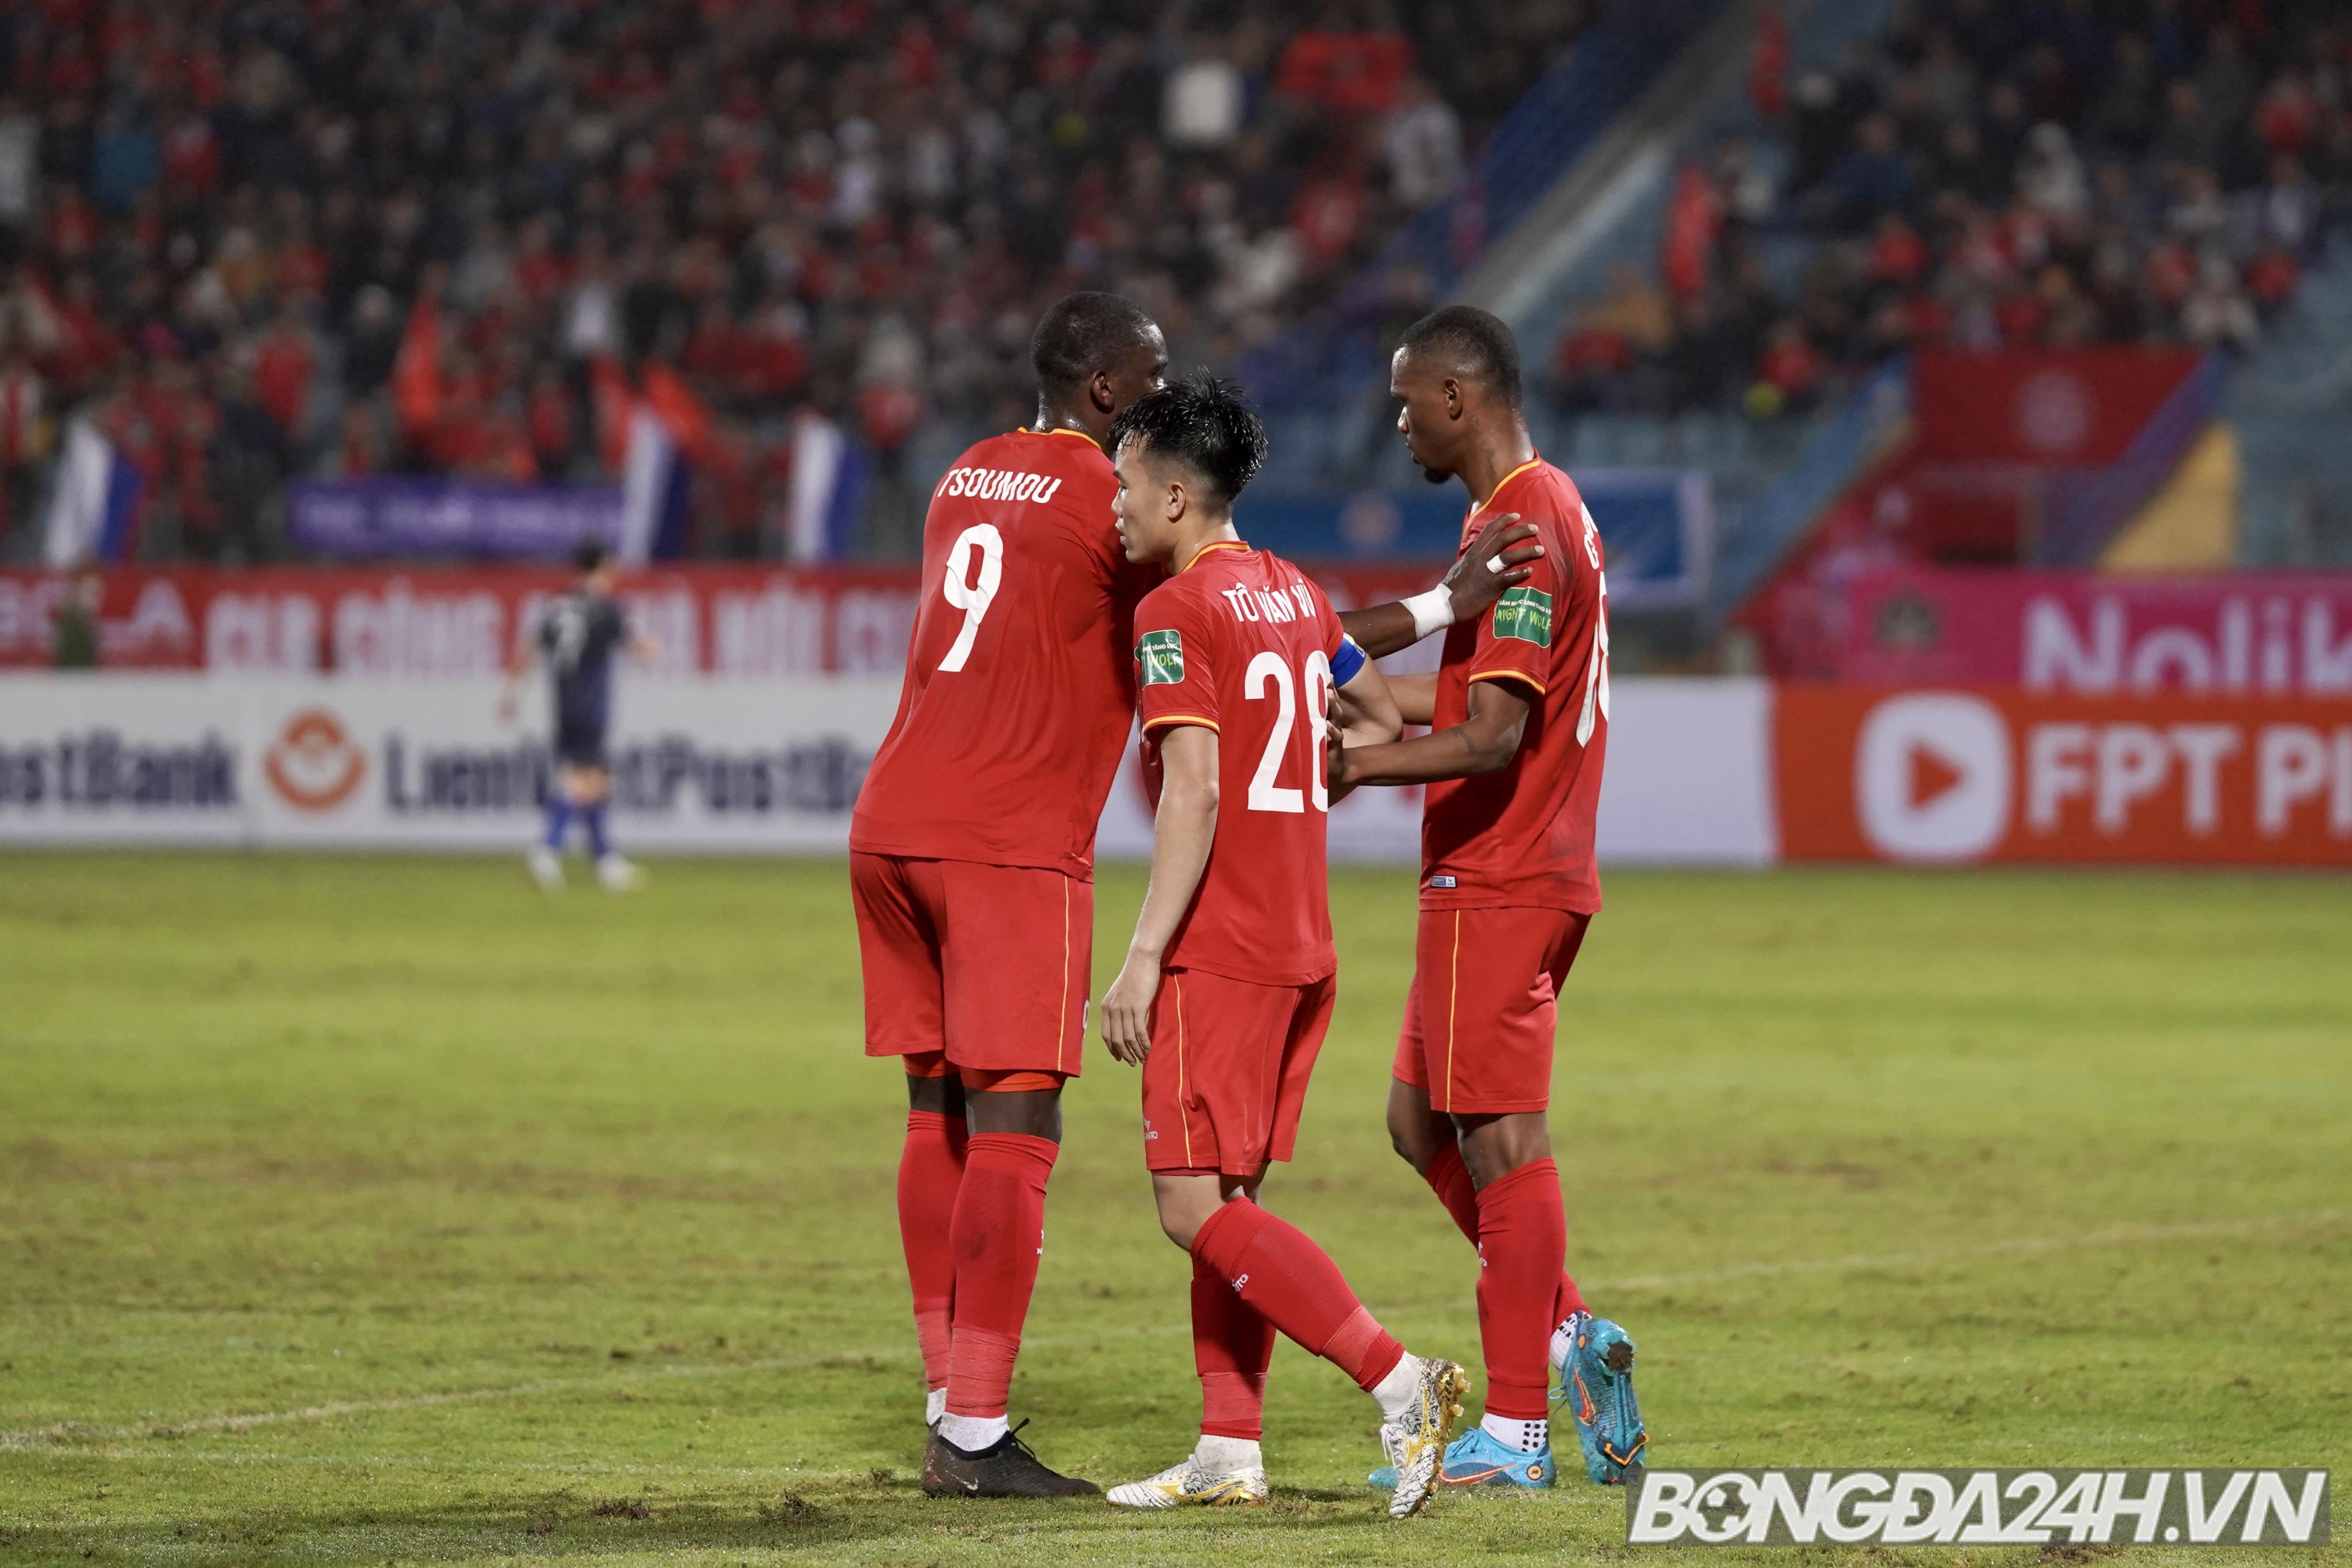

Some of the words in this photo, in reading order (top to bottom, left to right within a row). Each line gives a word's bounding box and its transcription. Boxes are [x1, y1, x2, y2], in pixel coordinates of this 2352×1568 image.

[937, 467, 1062, 504] TSOUMOU
[938, 522, 1004, 673] 9
[1222, 583, 1259, 622] TÔ
[1254, 585, 1296, 623] VĂN
[1496, 607, 1527, 624] NIGHT
[1244, 650, 1331, 813] 28
[2024, 723, 2242, 837] FPT
